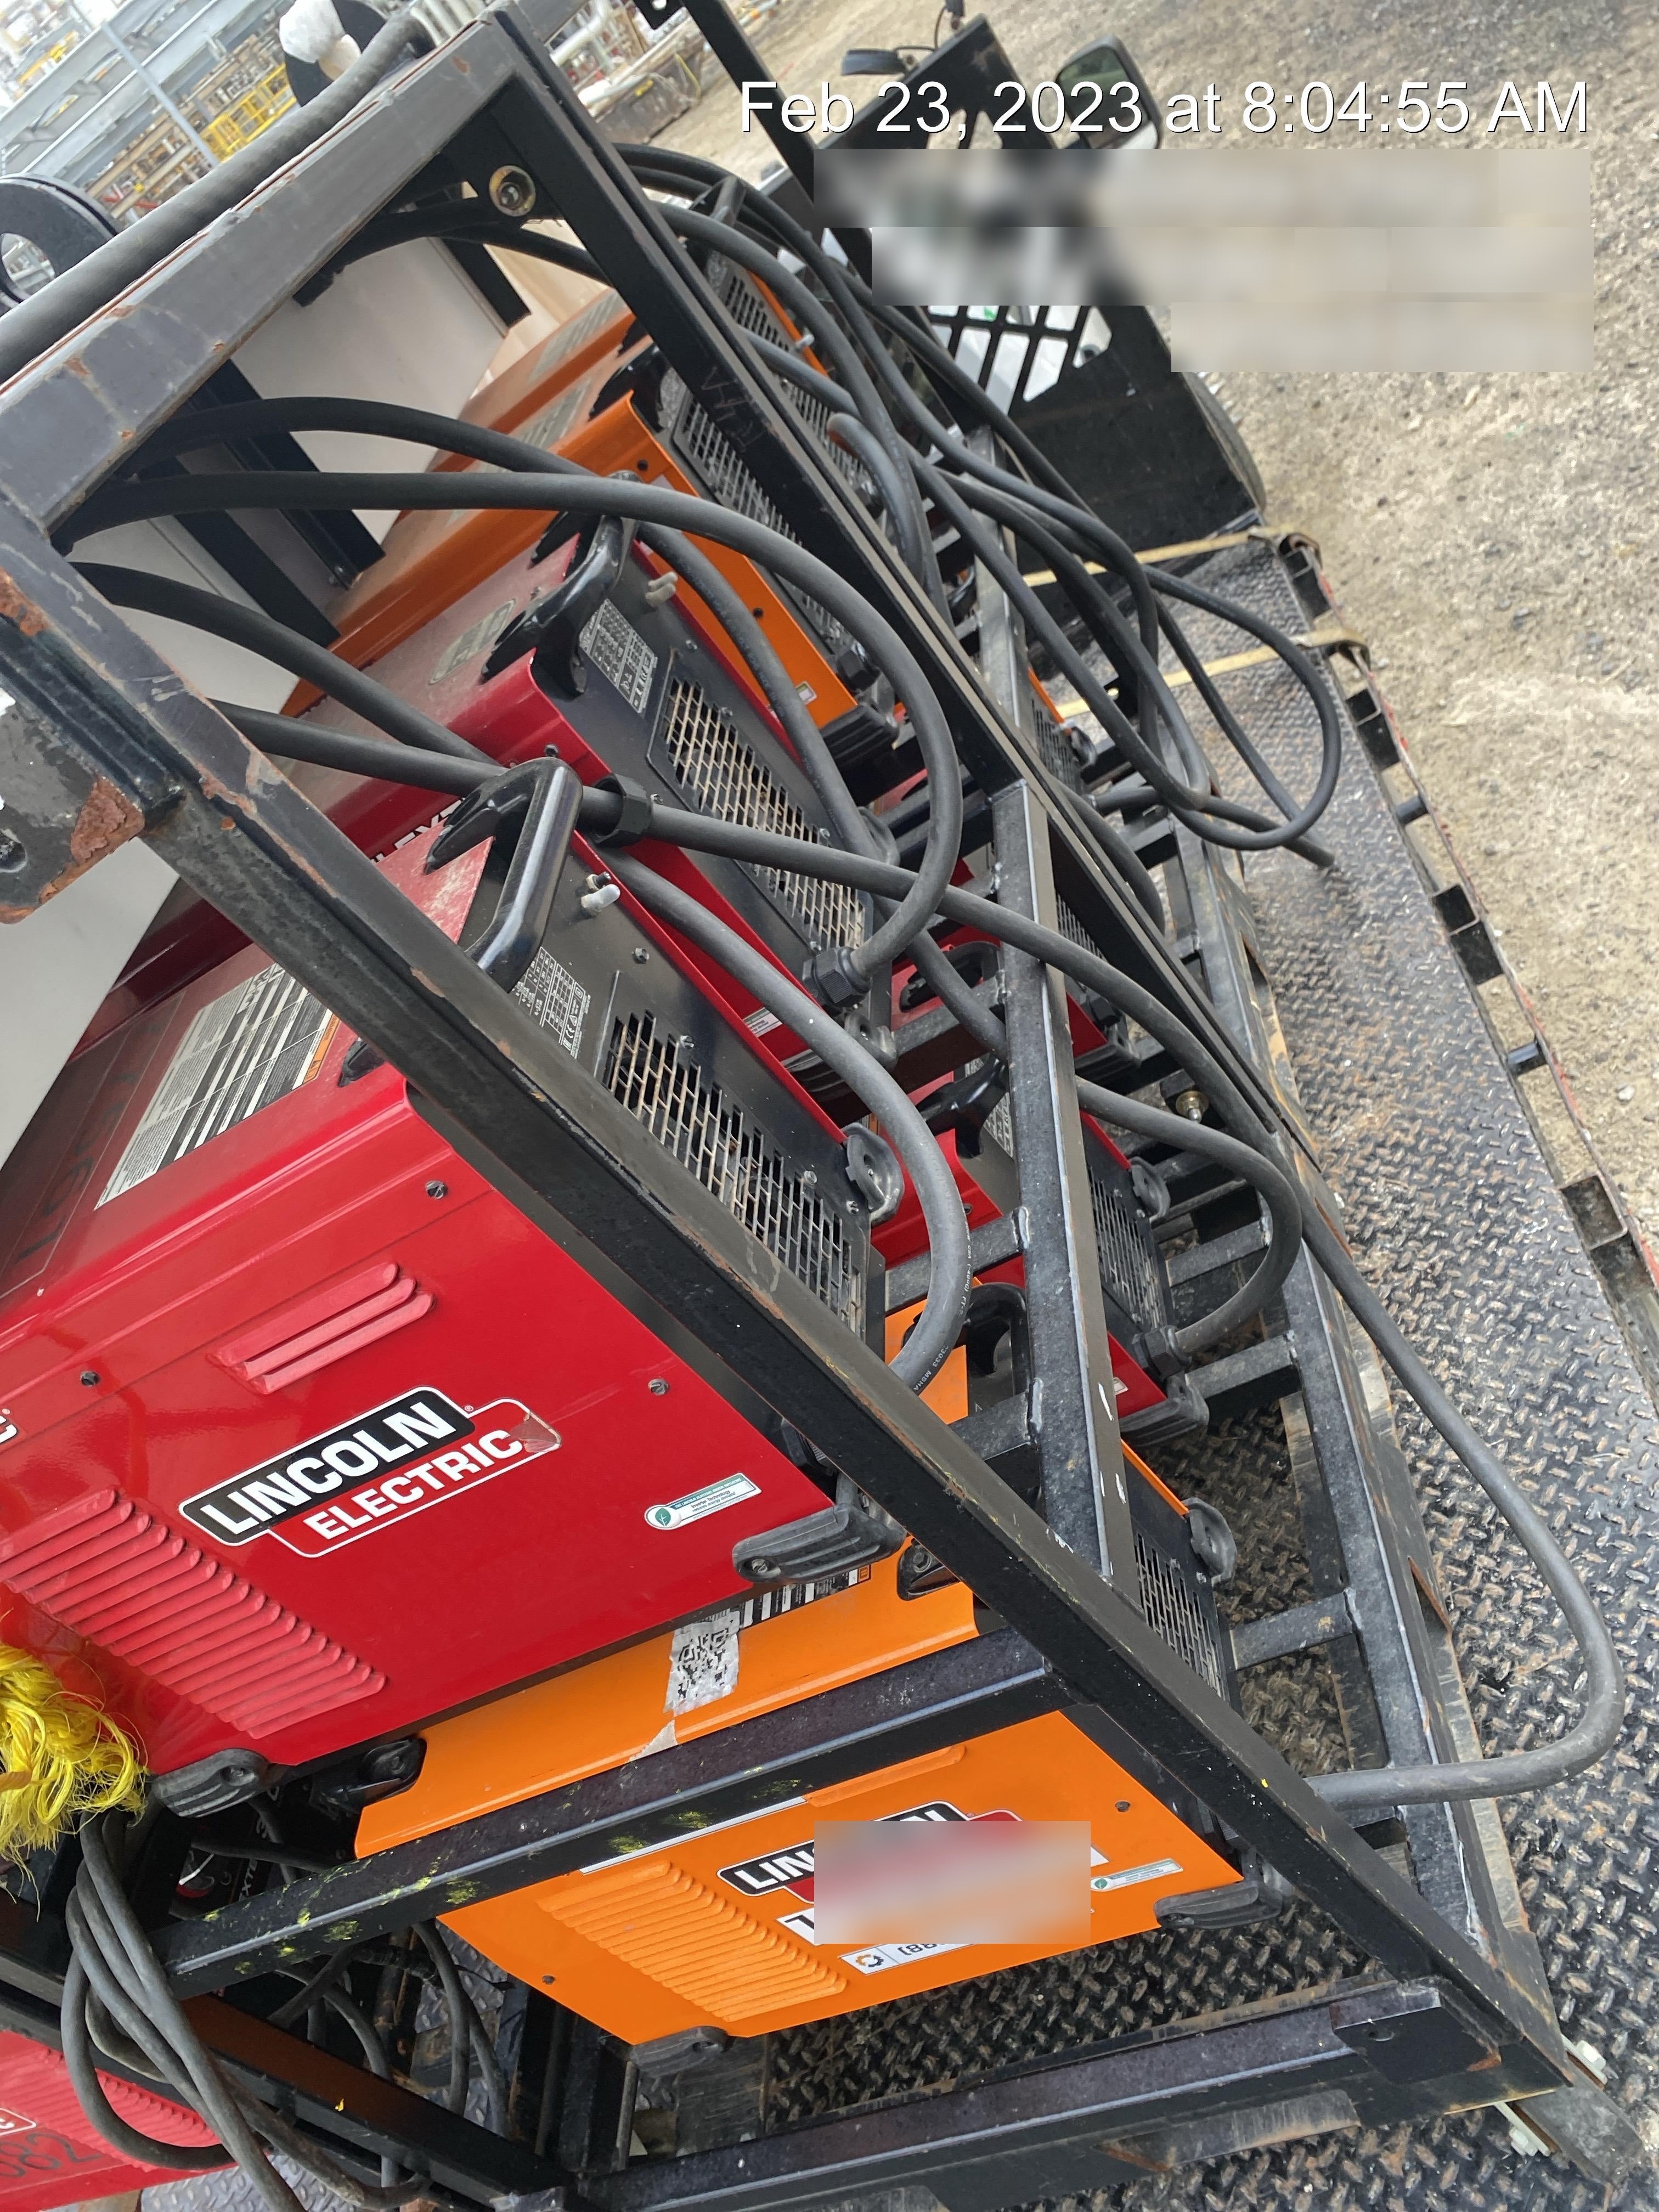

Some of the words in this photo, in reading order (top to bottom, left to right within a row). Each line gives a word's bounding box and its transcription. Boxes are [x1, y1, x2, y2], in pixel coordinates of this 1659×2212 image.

[913, 1370, 932, 1390] MSHA
[200, 1402, 456, 1535] LINCOLN
[303, 1430, 523, 1540] ELECTRIC
[708, 1489, 731, 1502] Technology
